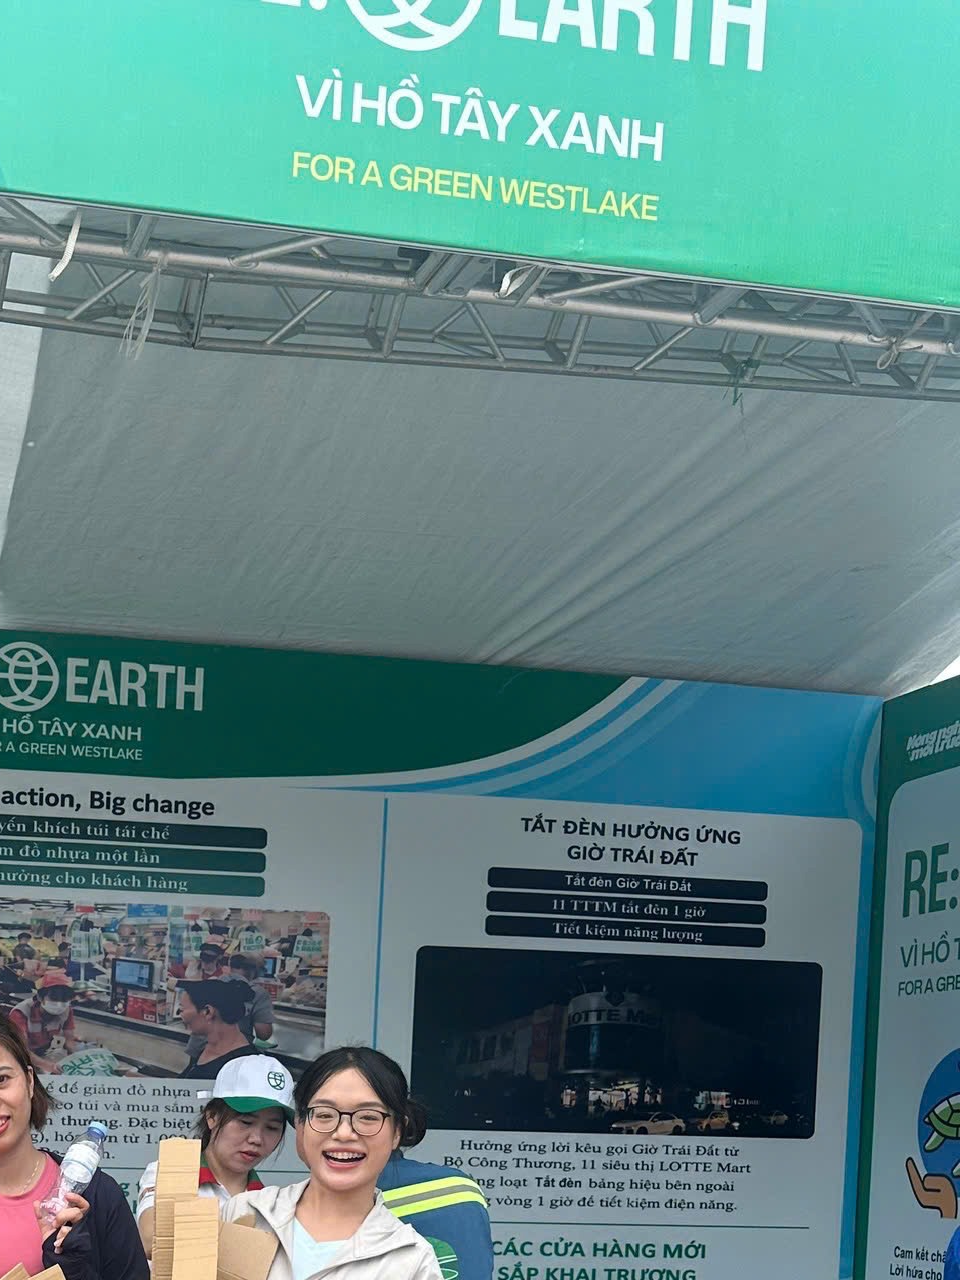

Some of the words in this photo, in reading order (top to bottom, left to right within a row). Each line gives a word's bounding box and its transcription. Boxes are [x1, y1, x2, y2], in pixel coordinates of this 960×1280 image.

[295, 69, 342, 121] VÌ
[352, 74, 424, 130] HỒ
[432, 87, 519, 142] TÂY
[526, 106, 664, 161] XANH
[292, 151, 355, 184] FOR
[361, 161, 383, 187] A
[390, 164, 493, 202] GREEN
[500, 176, 659, 221] WESTLAKE
[66, 658, 204, 712] EARTH
[2, 712, 34, 736] HỒ
[38, 716, 76, 738] TÂY
[80, 722, 142, 741] XANH
[4, 740, 16, 753] A
[18, 742, 67, 756] GREEN
[70, 744, 142, 760] WESTLAKE
[1, 786, 82, 812] action,
[89, 790, 126, 816] Big
[132, 793, 214, 819] change
[33, 820, 81, 835] khích
[87, 824, 108, 837] túi
[115, 825, 136, 838] tái
[141, 825, 170, 840] chế
[521, 813, 556, 833] TẮT
[563, 817, 605, 836] ĐÈN
[613, 820, 689, 841] HƯỞNG
[696, 822, 741, 844] ỨNG
[19, 842, 40, 857] đồ
[46, 847, 89, 861] nhựa
[95, 849, 128, 864] một
[134, 849, 160, 864] lần
[568, 842, 605, 861] GIỜ
[610, 845, 653, 864] TRÁI
[660, 847, 698, 867] ĐẤT
[55, 872, 85, 885] cho
[91, 872, 141, 888] khách
[147, 875, 188, 892] hàng
[565, 873, 585, 887] Tắt
[589, 875, 612, 888] đèn
[616, 878, 639, 889] Giờ
[644, 878, 667, 890] Trái
[670, 879, 692, 892] Đất
[571, 899, 617, 912] TTTM
[621, 901, 638, 915] tắt
[644, 902, 668, 915] đèn
[674, 906, 679, 917] 1
[685, 906, 706, 919] giờ
[553, 922, 581, 935] Tiết
[586, 923, 620, 939] kiệm
[624, 927, 658, 941] năng
[662, 928, 702, 942] lượng
[900, 939, 918, 968] VÌ
[922, 930, 950, 966] HỒ
[898, 979, 922, 996] FOR
[924, 978, 933, 994] A
[518, 1141, 547, 1154] ứng
[552, 1142, 570, 1152] lời
[575, 1143, 601, 1153] kêu
[606, 1145, 627, 1156] gọi
[633, 1144, 658, 1155] Giờ
[662, 1145, 690, 1155] Trái
[696, 1145, 719, 1156] Đất
[725, 1146, 739, 1156] từ
[444, 1157, 463, 1168] Bộ
[468, 1157, 507, 1170] Công
[513, 1158, 575, 1171] Thương,
[581, 1160, 595, 1169] 11
[602, 1160, 630, 1170] siêu
[635, 1161, 654, 1173] thị
[660, 1162, 712, 1172] LOTTE
[717, 1163, 751, 1173] Mart
[493, 1241, 532, 1256] CÁC
[540, 1237, 585, 1257] CỬA
[593, 1239, 656, 1258] HÀNG
[663, 1243, 706, 1259] MỚI
[894, 1246, 913, 1259] Cam
[916, 1246, 928, 1261] kết
[890, 1264, 903, 1276] Lời
[906, 1266, 923, 1279] hứa
[925, 1268, 942, 1280] cho
